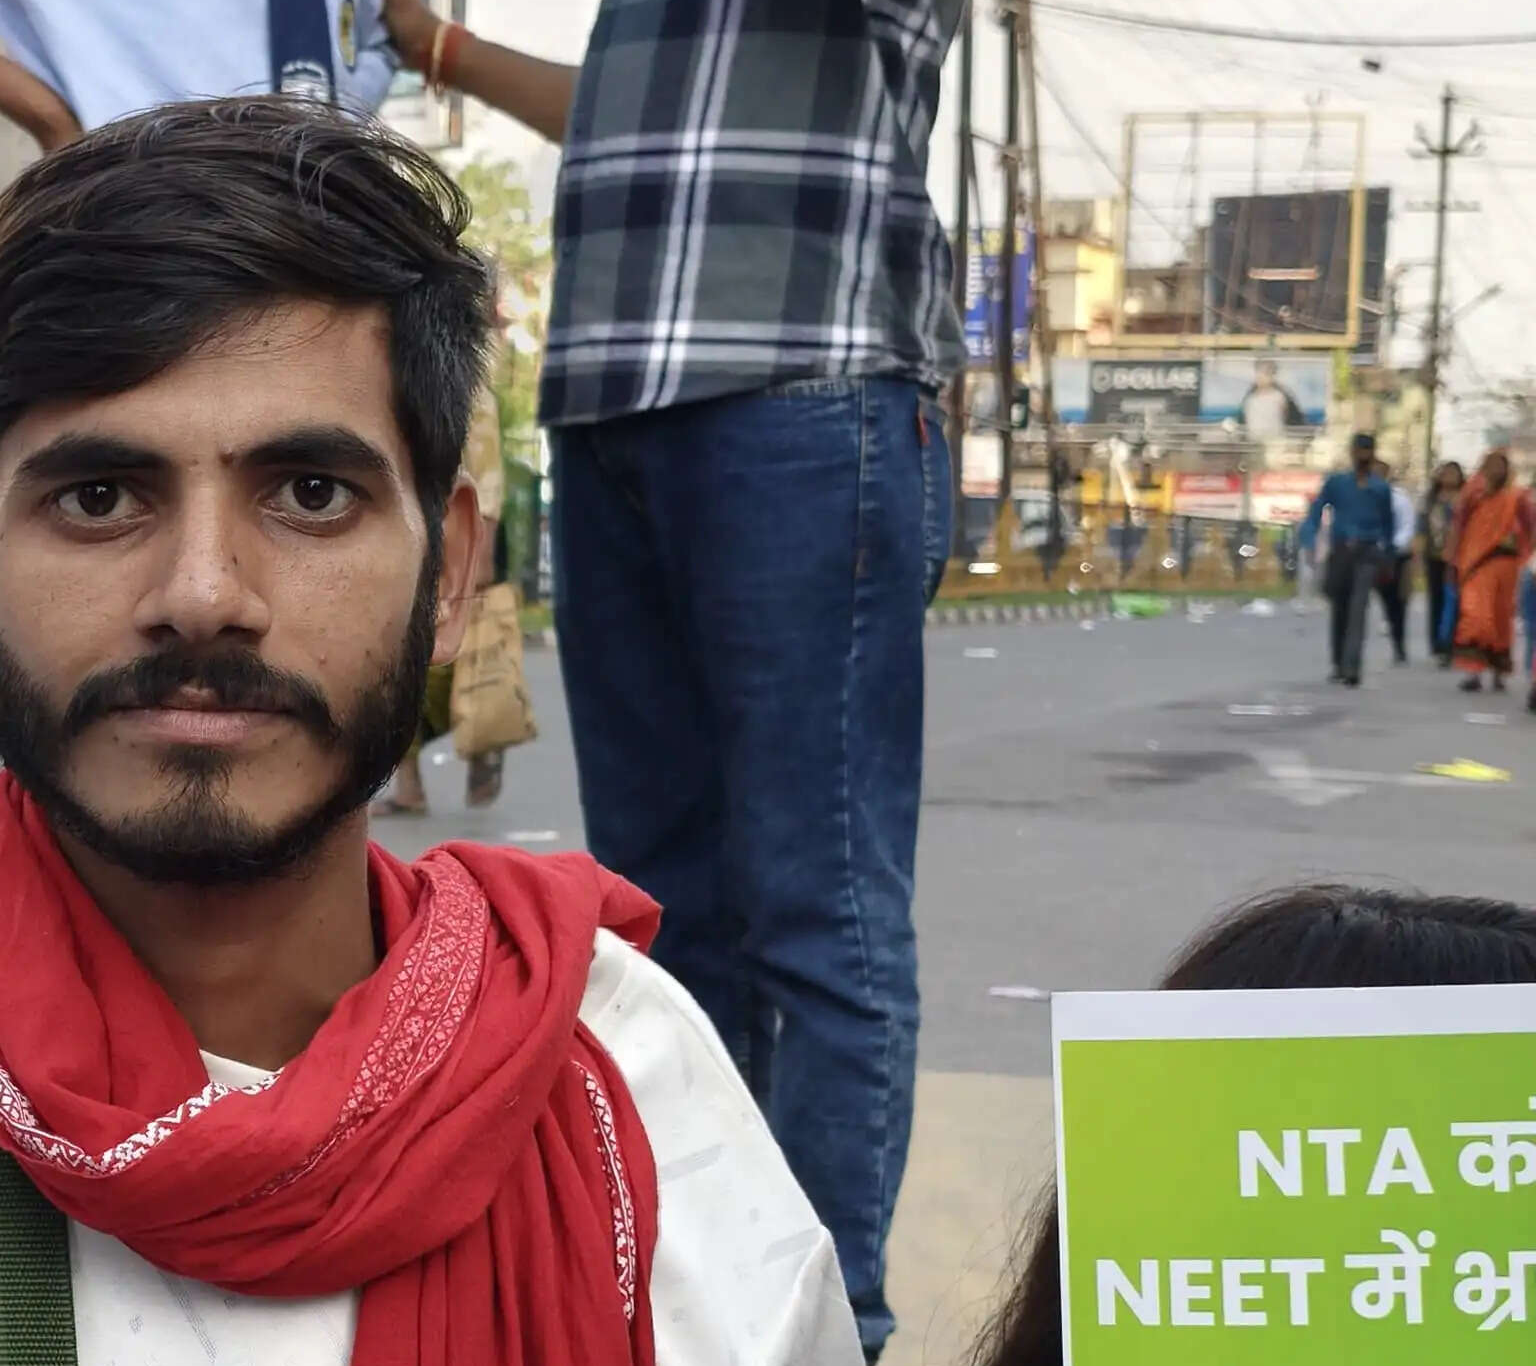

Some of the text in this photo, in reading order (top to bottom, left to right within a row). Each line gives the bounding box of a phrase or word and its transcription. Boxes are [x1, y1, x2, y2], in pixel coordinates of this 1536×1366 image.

[1238, 1095, 1536, 1197] NTA क
[1096, 1229, 1536, 1331] NEET में भ्र
